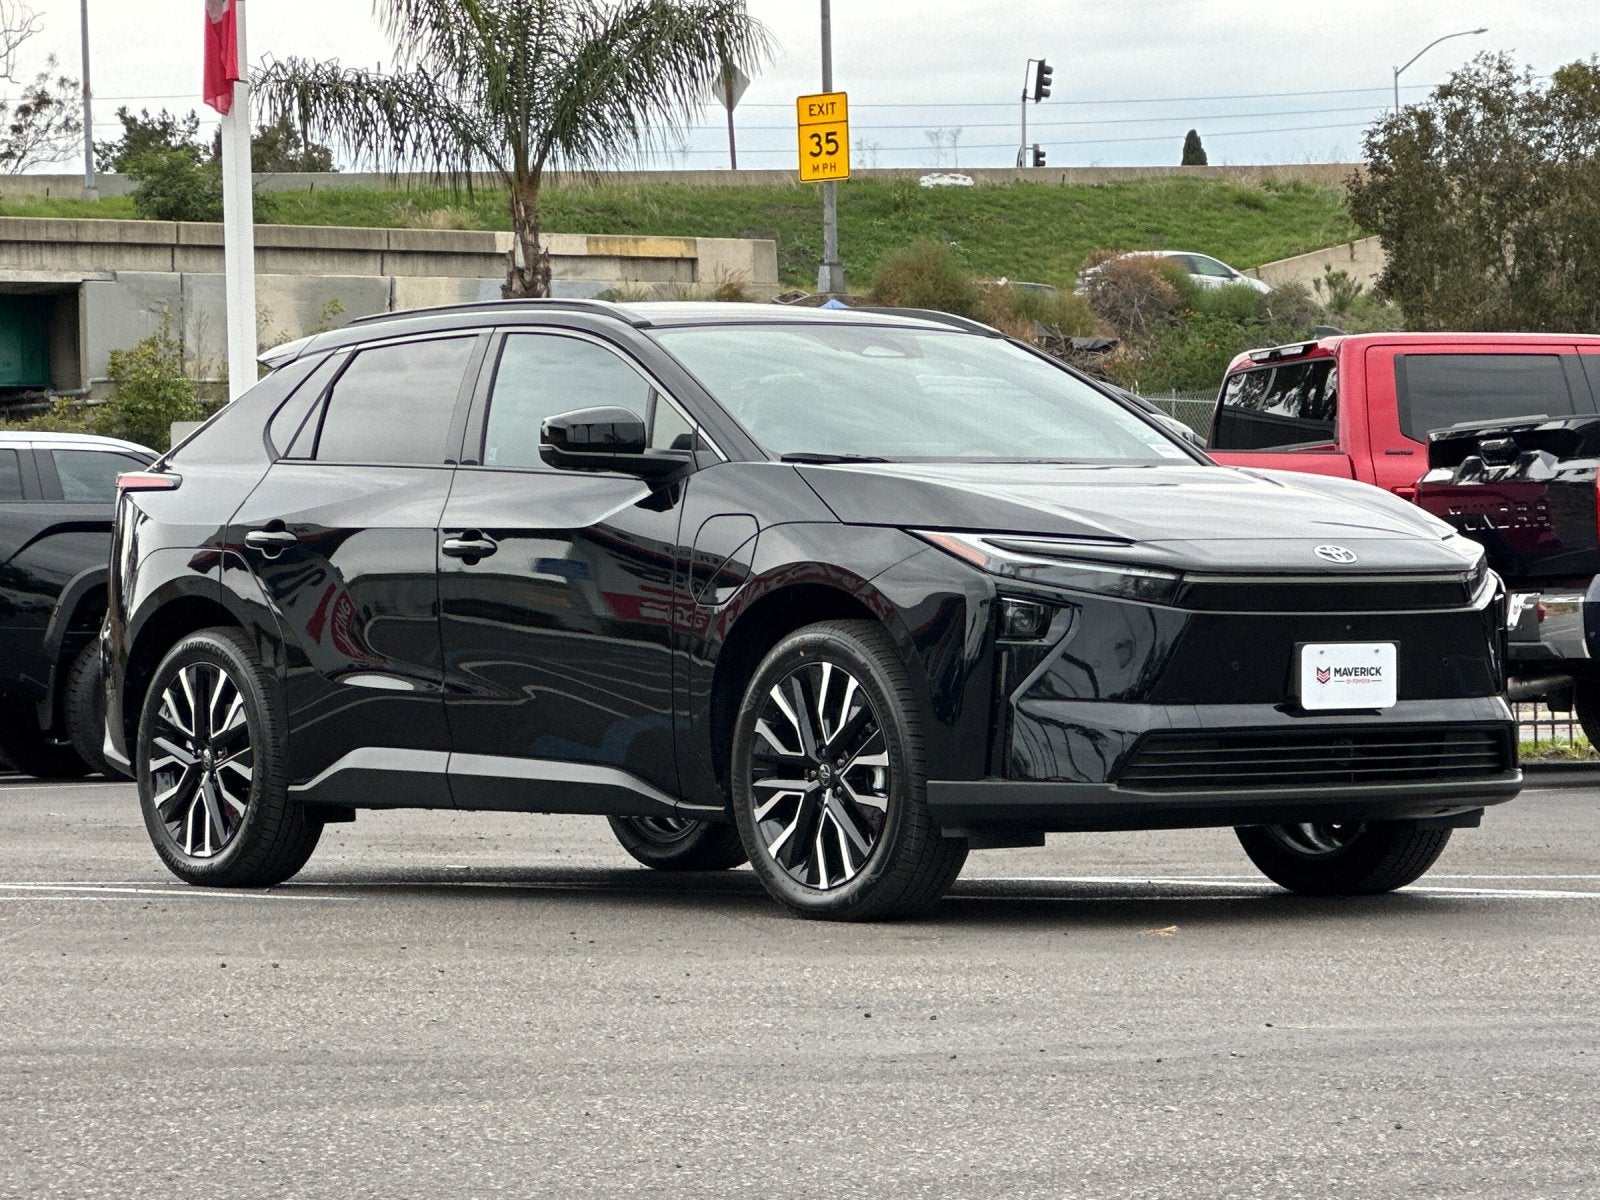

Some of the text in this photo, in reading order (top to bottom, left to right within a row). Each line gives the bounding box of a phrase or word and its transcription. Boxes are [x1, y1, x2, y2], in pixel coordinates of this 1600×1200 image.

[808, 102, 836, 116] EXIT
[809, 131, 839, 158] 35
[812, 162, 837, 174] MPH
[1334, 667, 1382, 677] MAVERICK
